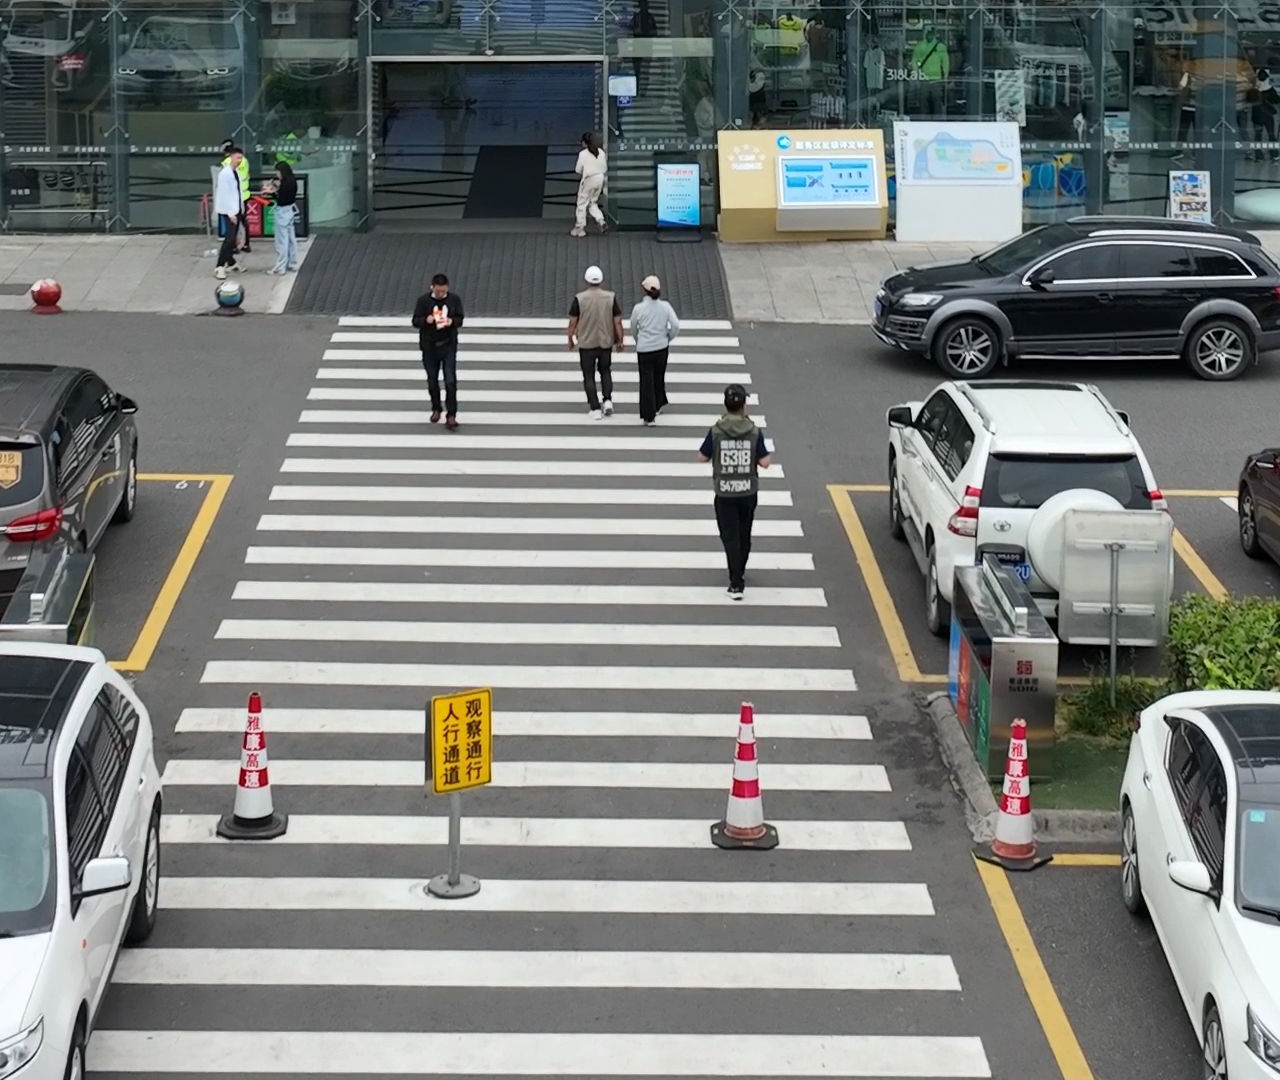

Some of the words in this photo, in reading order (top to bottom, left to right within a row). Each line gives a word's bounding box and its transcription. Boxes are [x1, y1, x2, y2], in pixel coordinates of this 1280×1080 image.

[720, 450, 751, 466] G318
[442, 702, 460, 786] 人行通道
[465, 698, 483, 782] 观察通行
